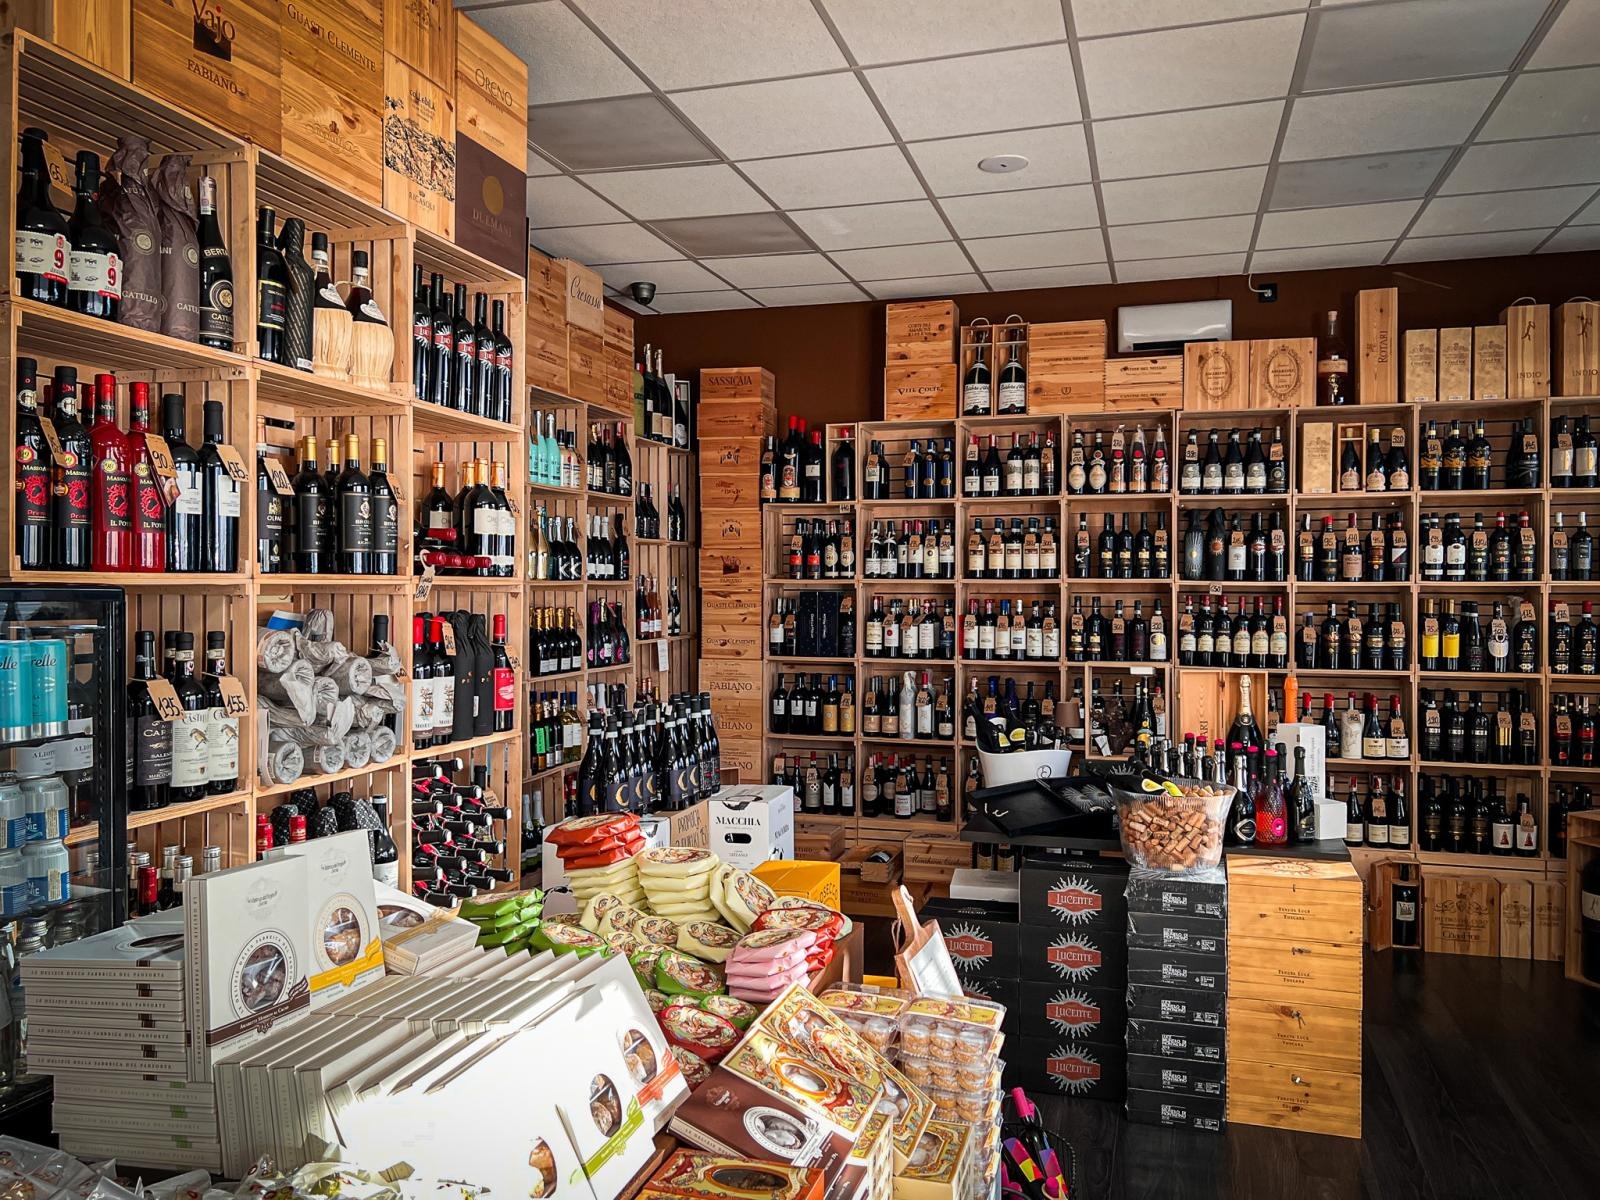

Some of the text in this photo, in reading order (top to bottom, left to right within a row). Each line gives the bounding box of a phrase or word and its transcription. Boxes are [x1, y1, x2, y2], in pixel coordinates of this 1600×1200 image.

[327, 30, 376, 73] CLEMENTE
[187, 59, 238, 94] FABIANO
[474, 68, 513, 108] ORENO
[53, 250, 64, 269] 9
[107, 267, 117, 286] 9
[1378, 330, 1389, 363] ROTARI
[1516, 371, 1542, 380] INDIO
[1572, 368, 1598, 377] INDIO
[708, 375, 753, 386] SASSICAIA
[709, 681, 753, 691] FABIANO
[716, 816, 761, 826] MACCHIA
[1055, 893, 1094, 906] LUCENTE
[1055, 949, 1093, 963] LUCENTE
[1055, 1005, 1093, 1019] LUCENTE
[1055, 1061, 1093, 1075] LUCENTE
